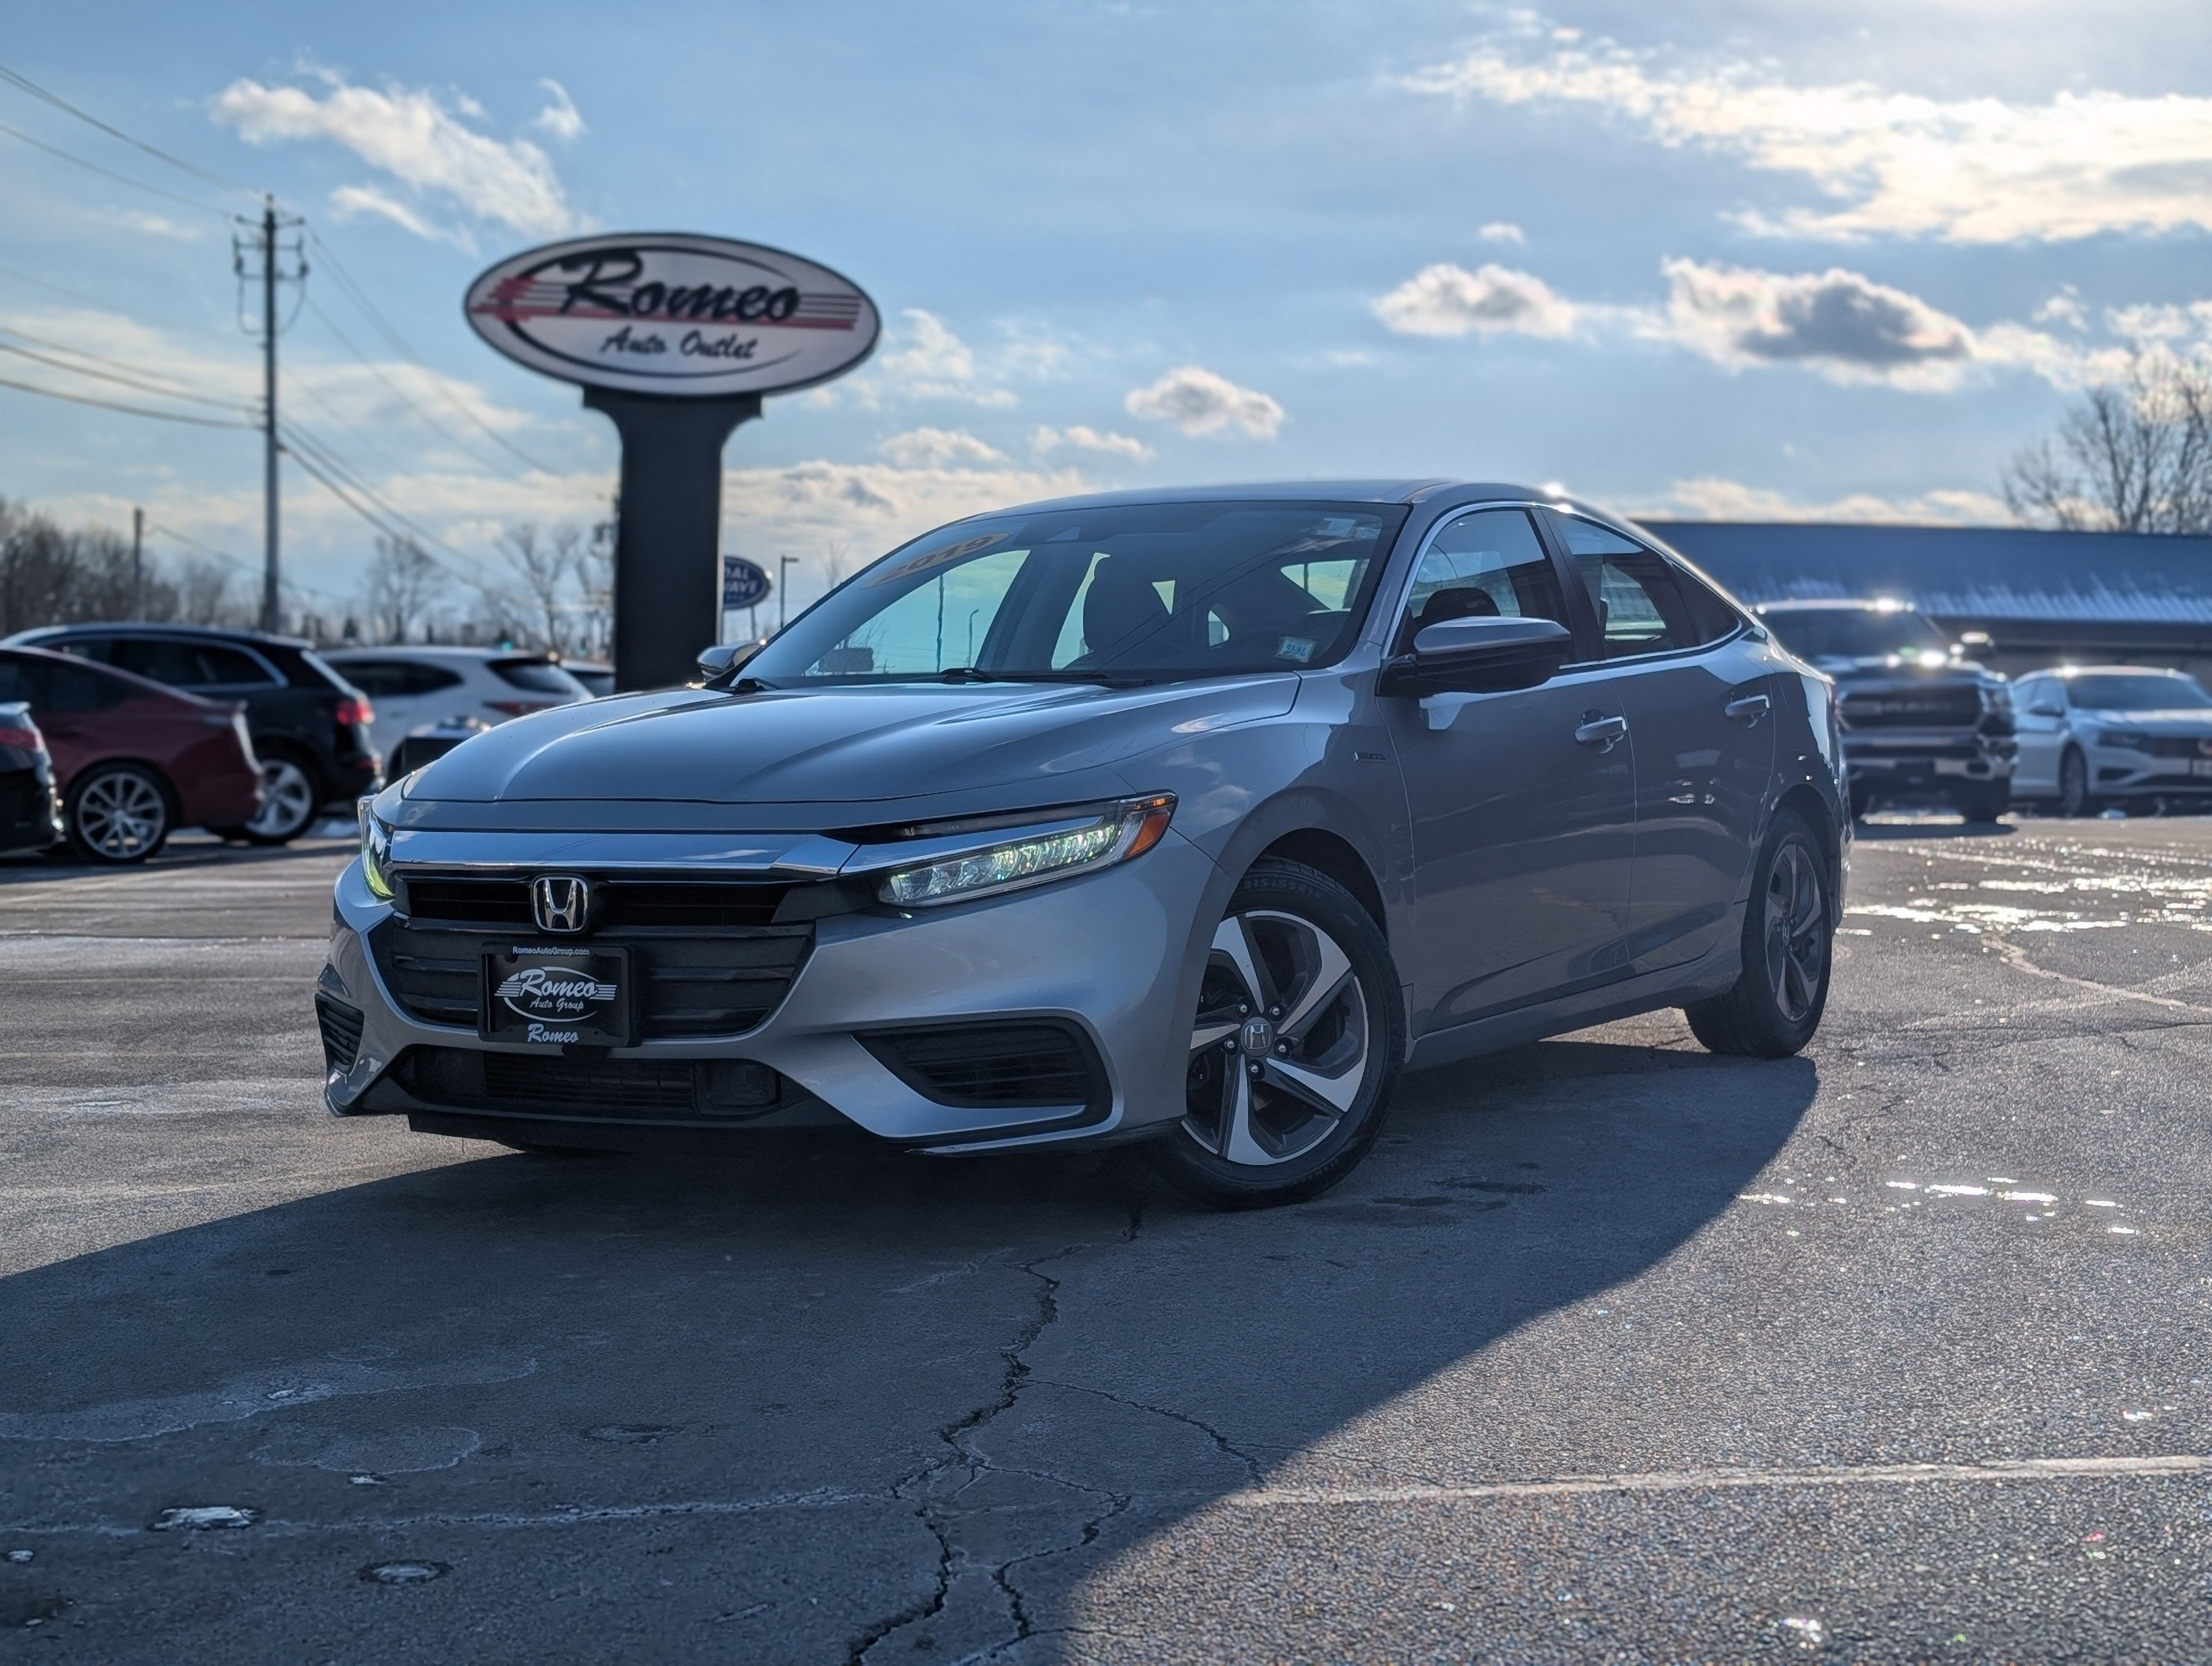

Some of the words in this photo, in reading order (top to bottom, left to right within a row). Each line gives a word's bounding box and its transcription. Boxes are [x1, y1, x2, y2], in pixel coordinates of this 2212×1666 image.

[558, 249, 801, 321] Romeo
[600, 326, 667, 354] Auto
[680, 330, 758, 359] Outlet
[512, 946, 590, 956] RomeoAutoGroup.com
[520, 969, 598, 997] Romeo
[530, 997, 553, 1009] Auto
[556, 998, 584, 1012] Group
[527, 1023, 579, 1043] Romeo
